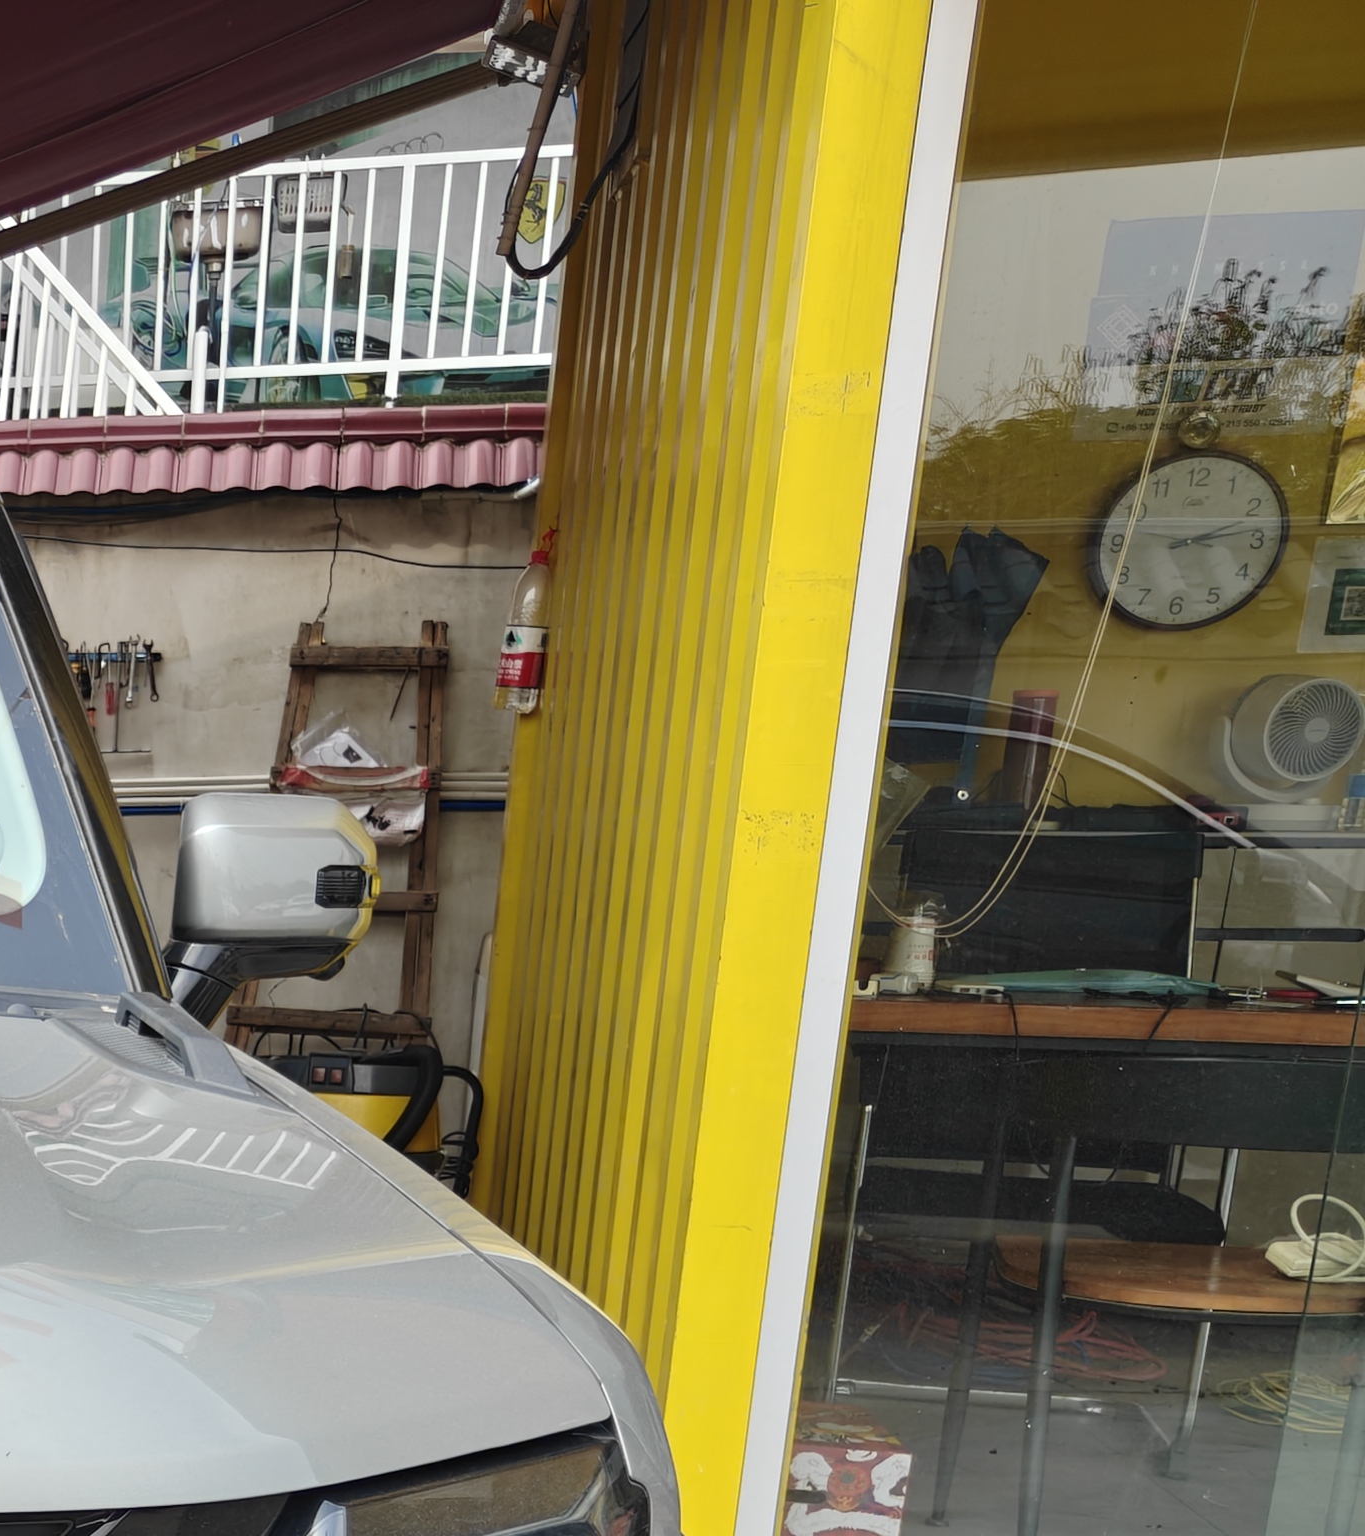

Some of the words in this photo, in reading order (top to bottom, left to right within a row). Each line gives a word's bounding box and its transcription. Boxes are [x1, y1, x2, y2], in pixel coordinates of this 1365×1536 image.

[1187, 467, 1211, 488] 12
[1228, 476, 1237, 496] 1
[1152, 478, 1171, 499] 11
[1245, 498, 1262, 518] 2
[1109, 534, 1126, 554] 9
[1249, 530, 1265, 550] 3
[1235, 562, 1250, 581] 4
[1137, 588, 1152, 606] 7
[1168, 596, 1184, 616] 6
[1205, 587, 1221, 605] 5
